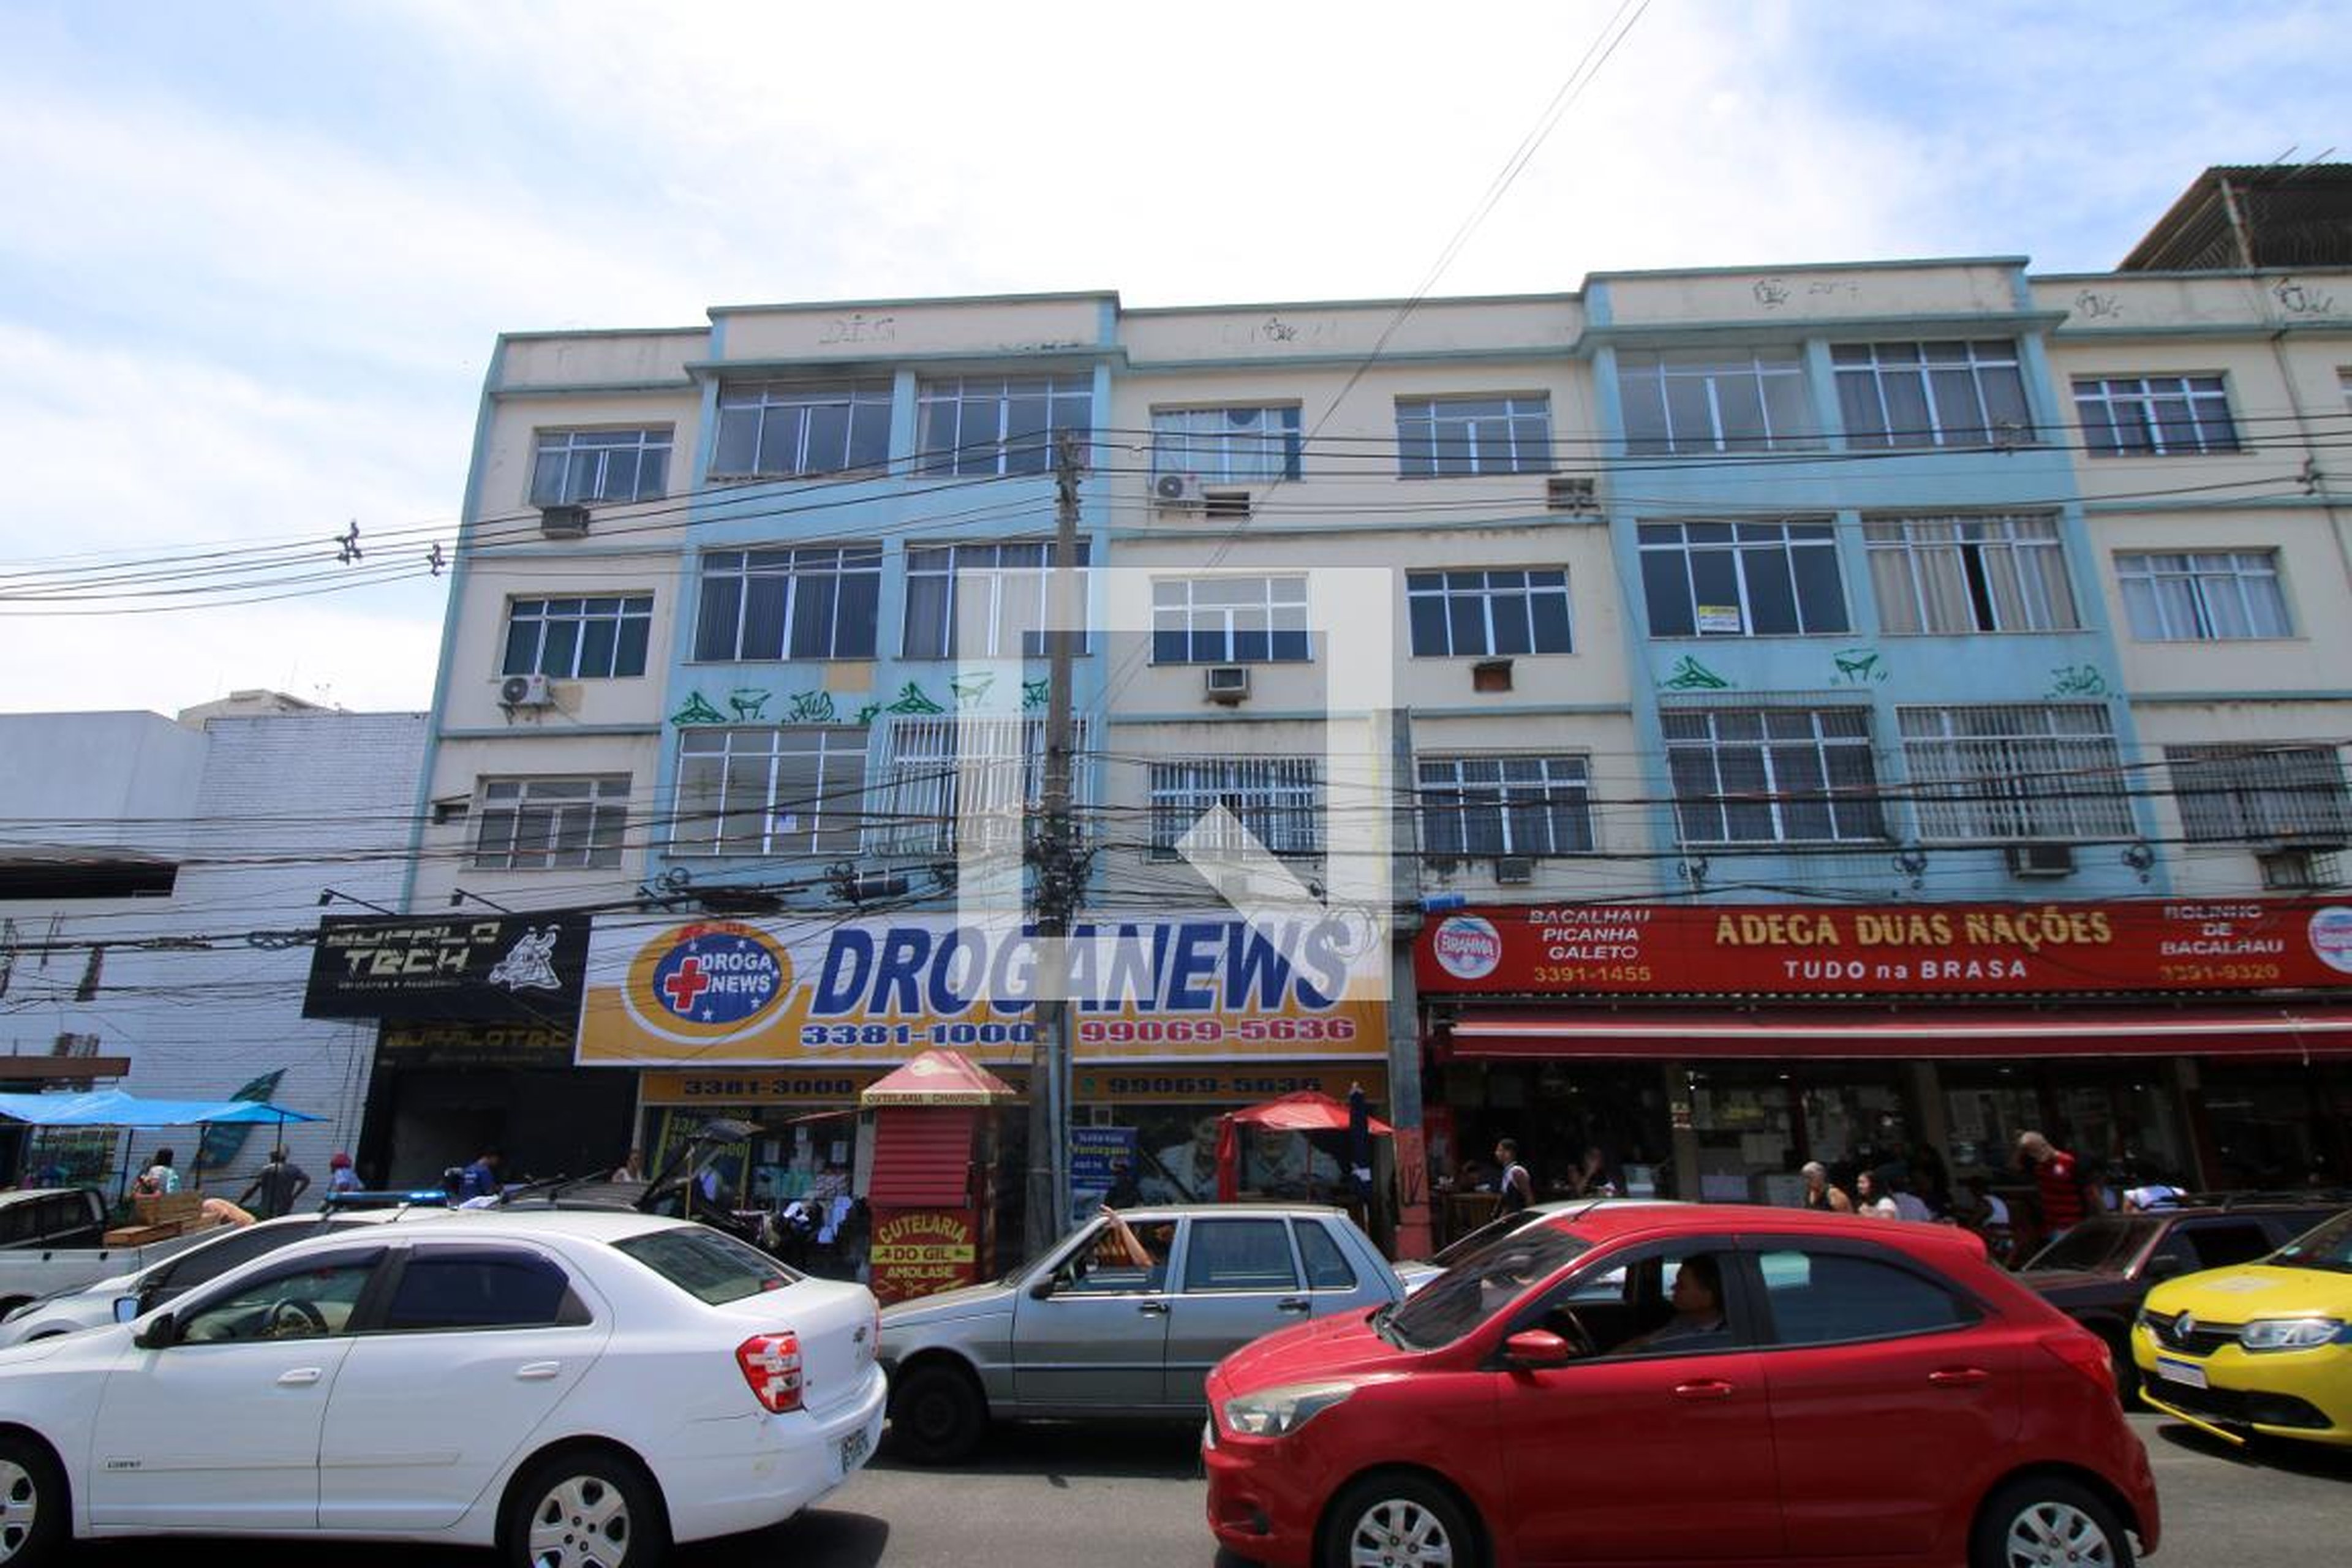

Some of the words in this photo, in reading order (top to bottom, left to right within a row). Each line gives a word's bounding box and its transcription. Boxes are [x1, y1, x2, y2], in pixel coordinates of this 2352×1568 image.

[1528, 908, 1651, 924] BACALHAU
[2163, 905, 2263, 920] BOLINHO
[1542, 927, 1640, 942] PICANHA
[1716, 913, 1839, 945] ADEGA
[1855, 913, 1953, 945] DUAS
[1964, 905, 2111, 952] NAÇÕES
[2202, 922, 2234, 936] DE
[1548, 945, 1638, 960] GALETO
[2160, 938, 2285, 956] BACALHAU
[344, 948, 470, 975] TECH
[701, 952, 772, 970] DROGA
[1783, 960, 1866, 979] TUDO
[1876, 963, 1909, 979] na
[1921, 960, 2026, 979] BRASA
[1534, 966, 1651, 982] 3391-1455
[711, 974, 771, 993] NEWS
[801, 1023, 1035, 1044] 3381-1000
[1079, 1019, 1355, 1042] 99069-5636
[879, 1215, 967, 1244] CUTELARIA
[894, 1248, 919, 1261] DO
[924, 1248, 949, 1261] GIL
